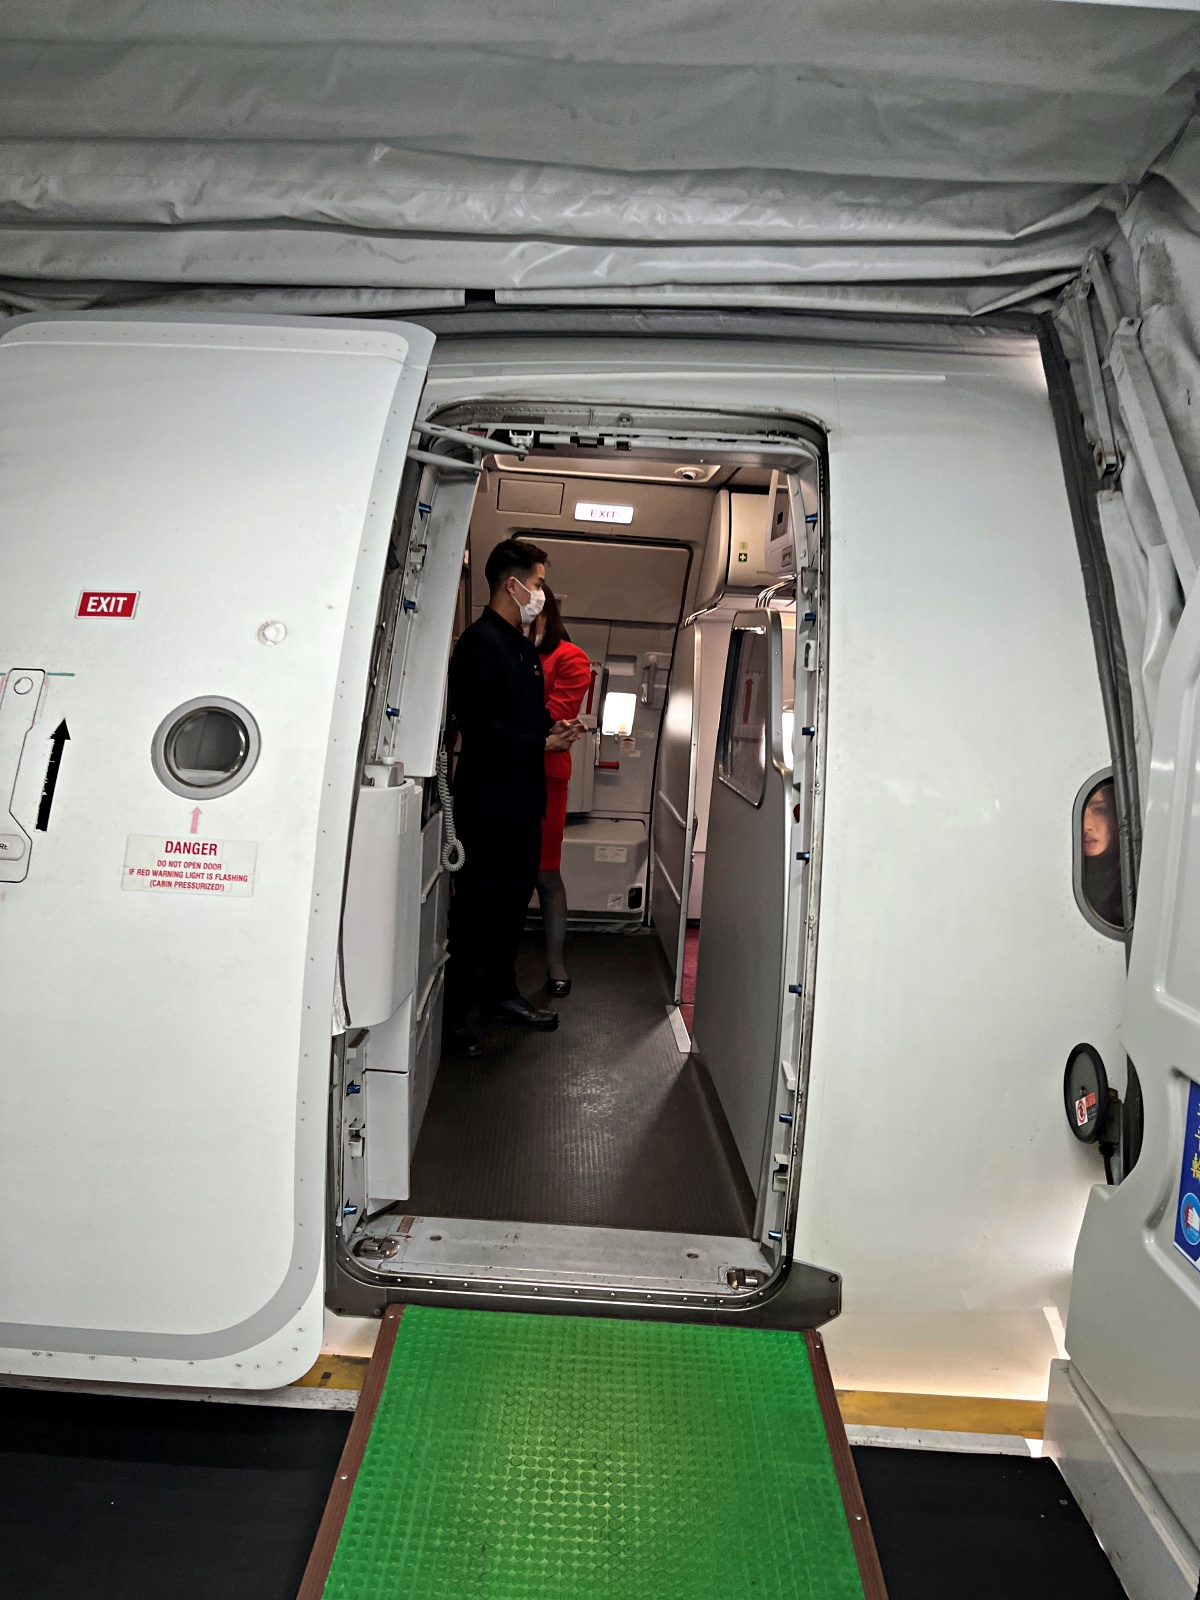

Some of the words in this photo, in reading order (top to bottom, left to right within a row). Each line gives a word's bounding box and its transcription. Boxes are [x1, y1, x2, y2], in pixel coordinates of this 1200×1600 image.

[591, 510, 617, 519] EXIT
[87, 596, 128, 613] EXIT
[164, 840, 218, 856] DANGER
[168, 860, 182, 868] NOT
[183, 861, 202, 869] OPEN
[152, 870, 184, 878] WARNING
[185, 872, 205, 880] LIGHT
[214, 874, 249, 882] FLASHING
[149, 879, 173, 888] (CABIN
